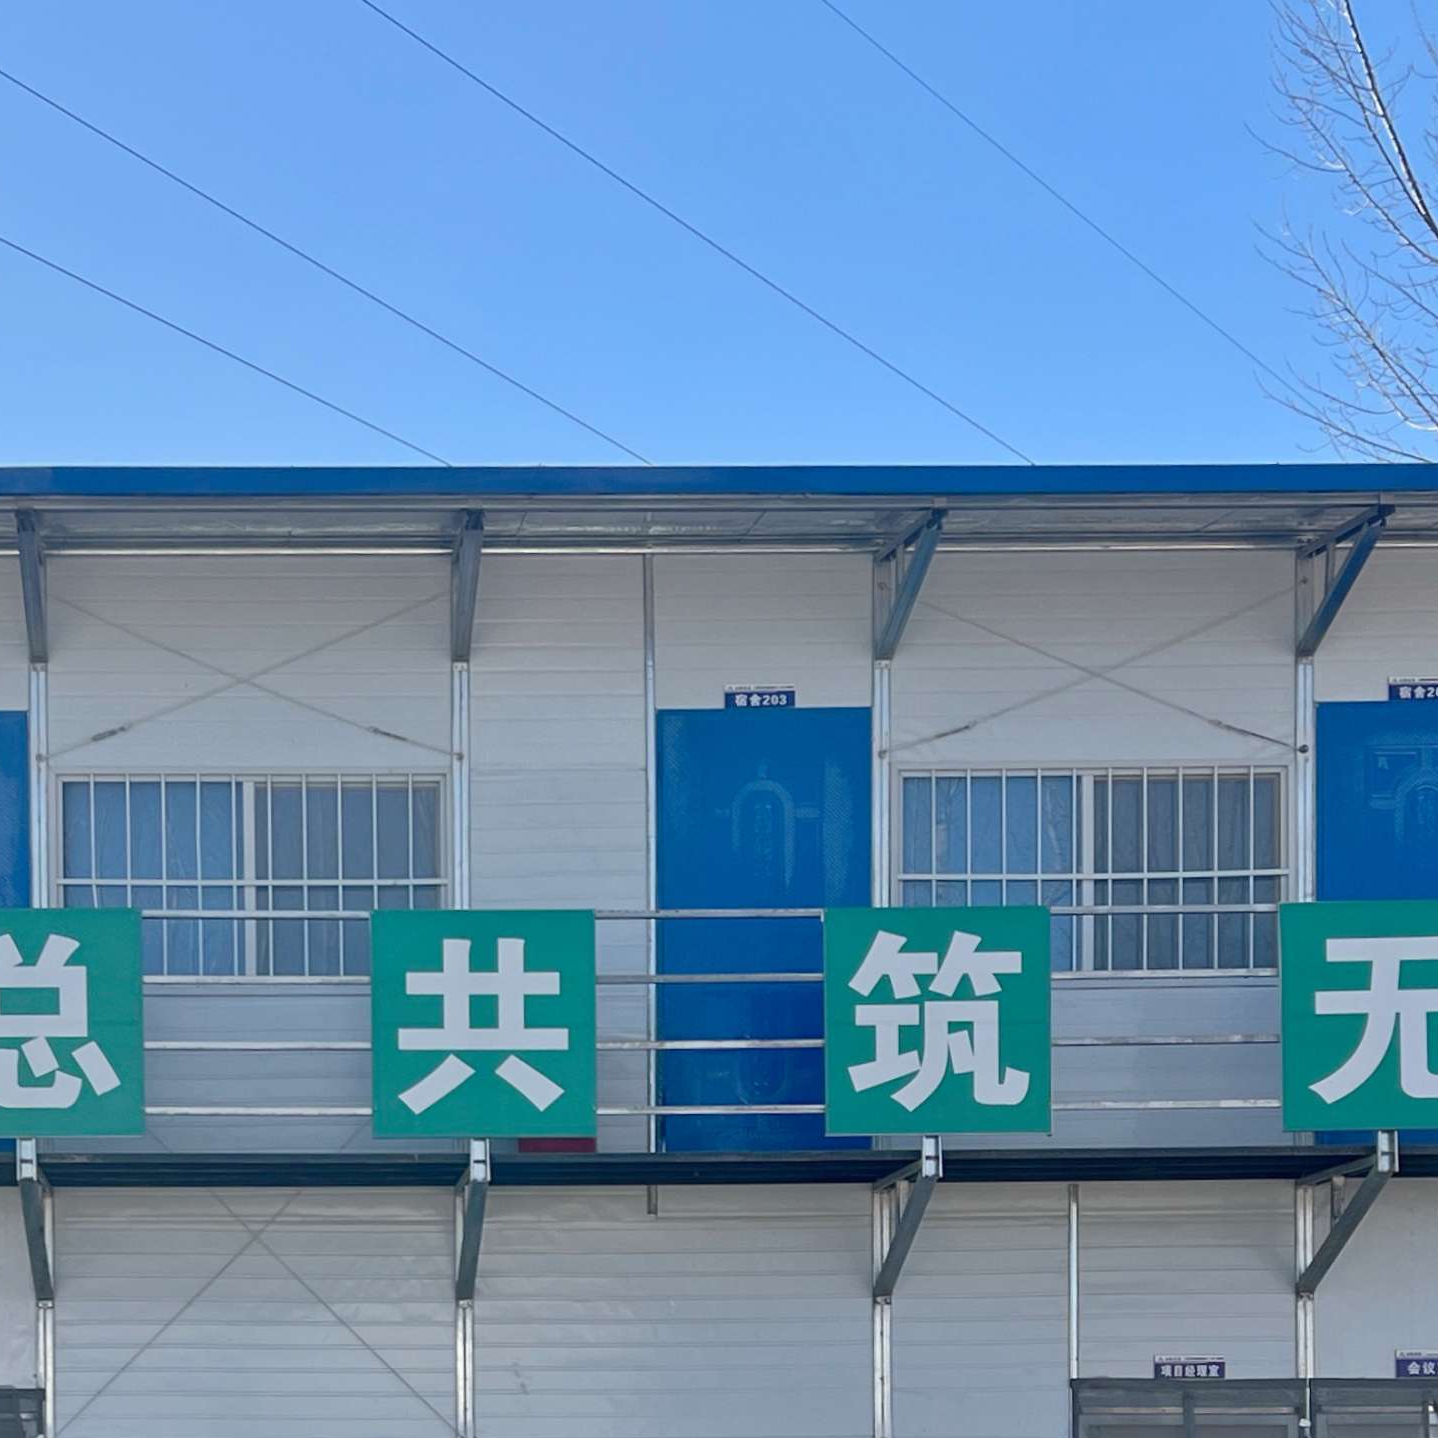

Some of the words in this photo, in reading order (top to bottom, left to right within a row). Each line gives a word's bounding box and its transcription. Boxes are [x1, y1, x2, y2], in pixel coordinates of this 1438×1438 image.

[735, 694, 788, 707] 宿舍203
[1161, 1365, 1220, 1378] 项目经理室
